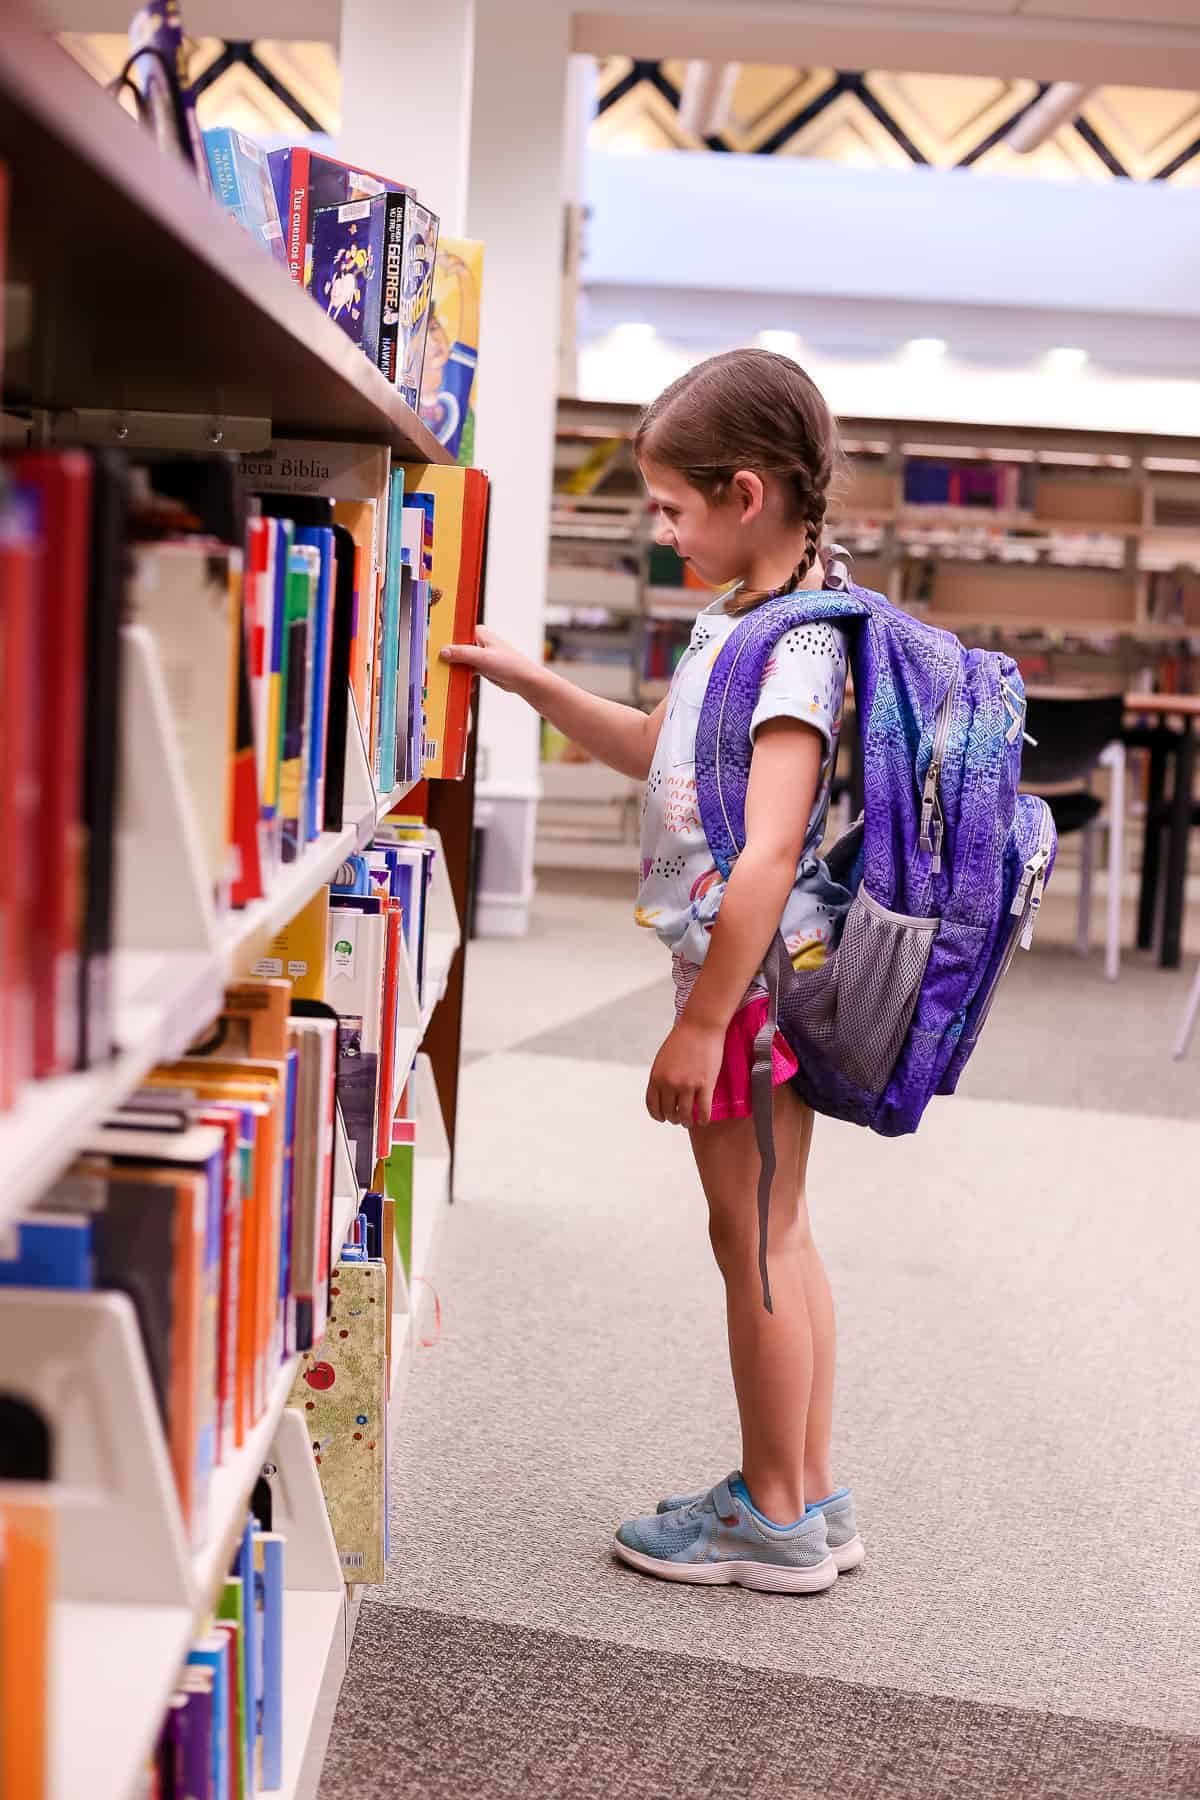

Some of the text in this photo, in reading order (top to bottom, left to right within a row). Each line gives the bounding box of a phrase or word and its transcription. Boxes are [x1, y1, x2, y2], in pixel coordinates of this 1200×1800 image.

[294, 188, 305, 210] Tus
[291, 212, 301, 259] cuentos
[385, 244, 402, 309] GEORGE
[280, 458, 329, 479] Biblia
